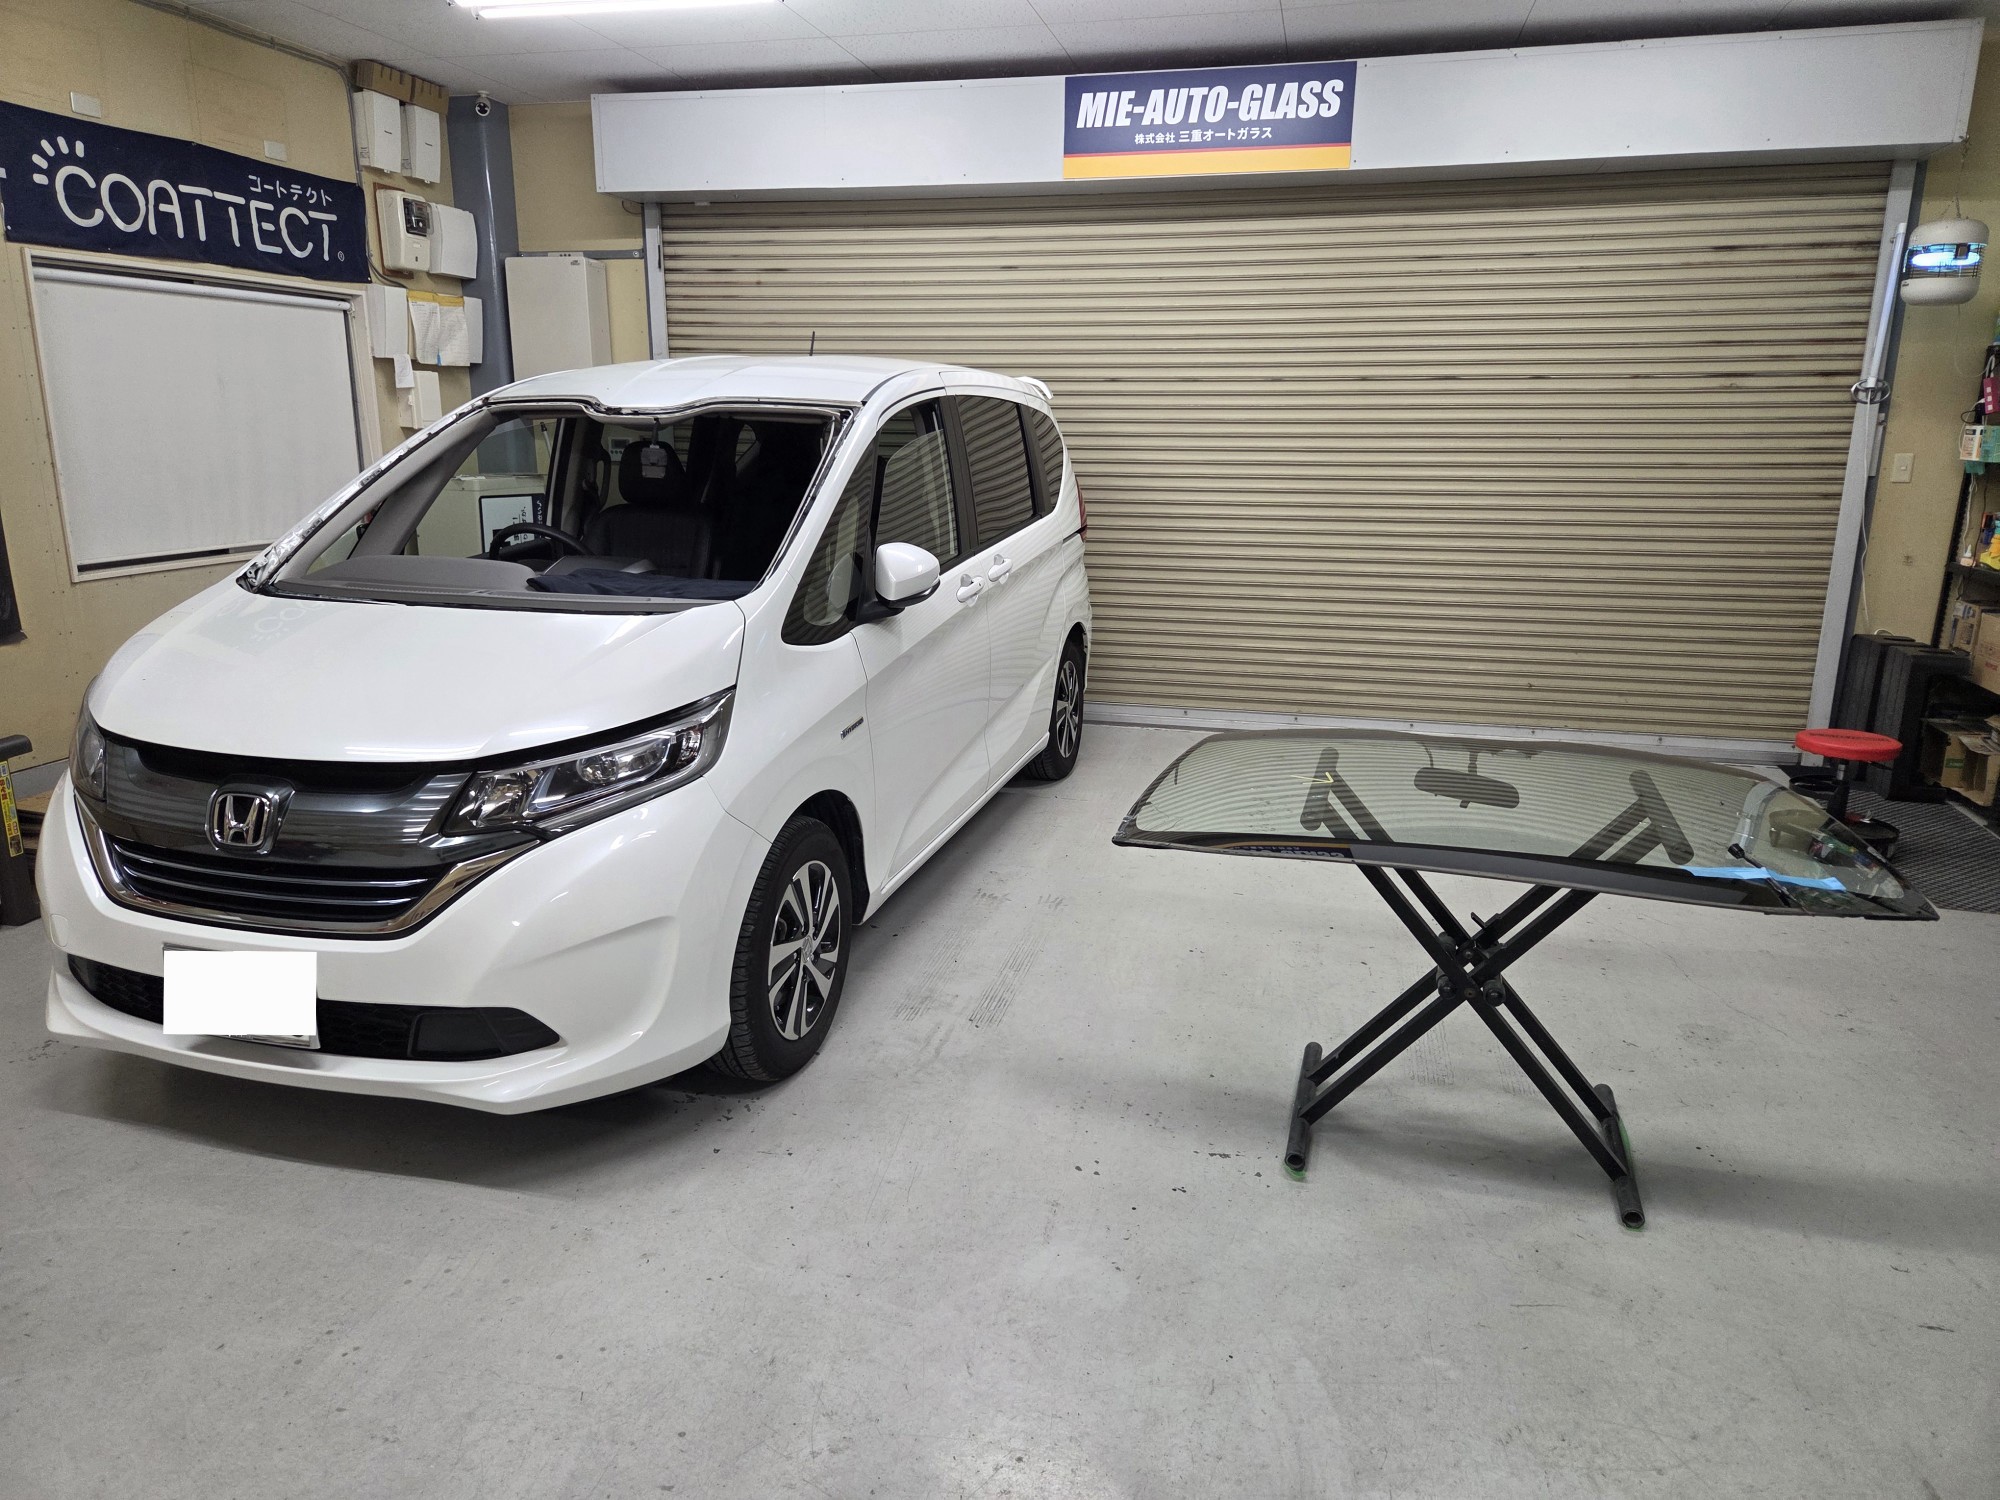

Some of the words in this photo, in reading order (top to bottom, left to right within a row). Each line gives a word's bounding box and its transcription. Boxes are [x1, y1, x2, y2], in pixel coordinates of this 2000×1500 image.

[1076, 79, 1344, 128] MIE-AUTO-GLASS
[1134, 132, 1176, 145] 株式会社
[1178, 127, 1273, 144] 三重オートガラス
[248, 175, 332, 206] コートテクト
[55, 165, 338, 262] COATTECT
